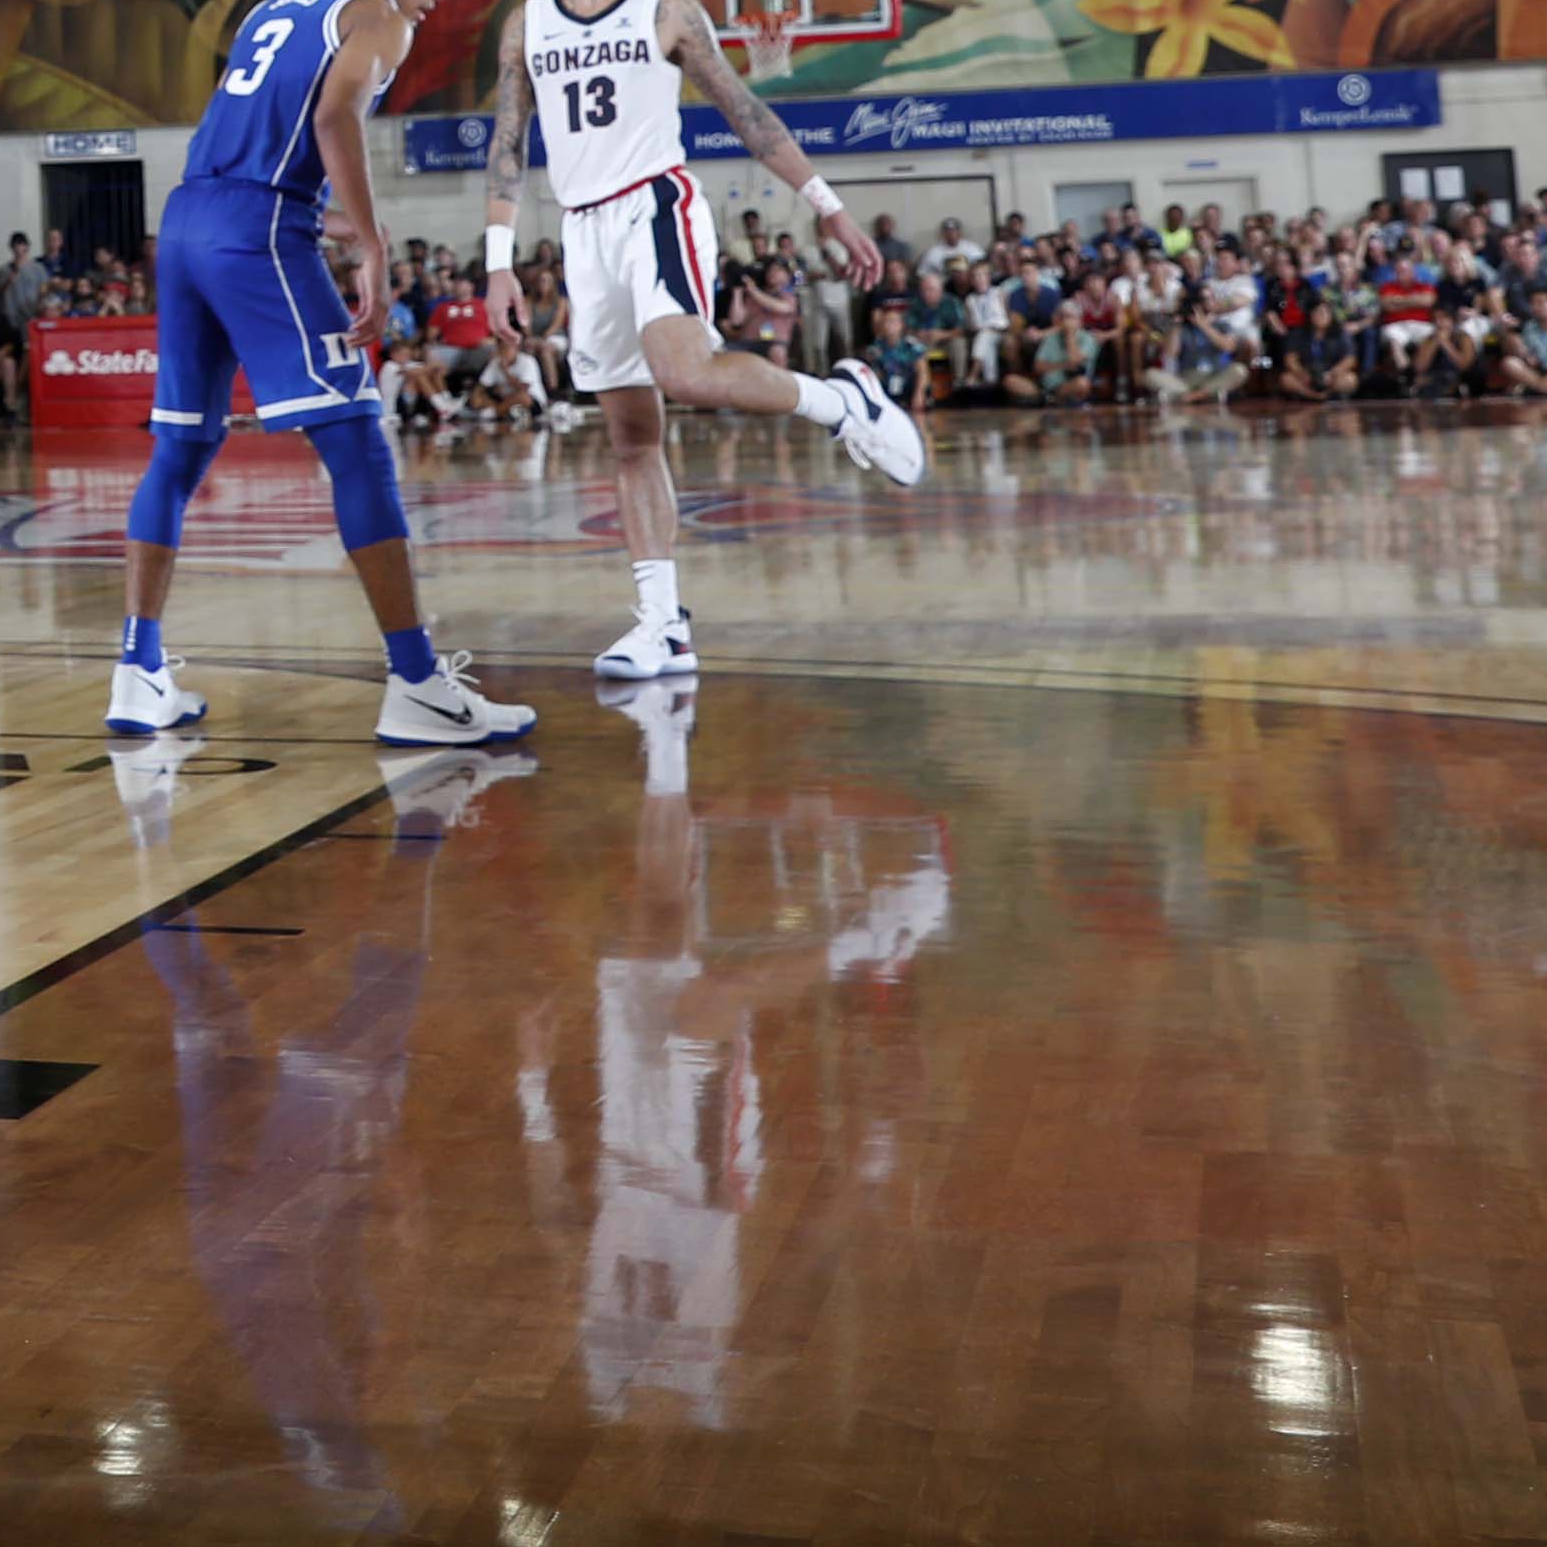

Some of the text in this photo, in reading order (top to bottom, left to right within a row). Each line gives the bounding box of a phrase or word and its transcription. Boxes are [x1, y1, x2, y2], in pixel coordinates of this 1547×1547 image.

[225, 17, 294, 96] 3
[532, 39, 652, 78] GONZAGA
[563, 75, 618, 134] 13
[911, 121, 966, 139] MAUI
[968, 114, 1114, 136] INVITATIONAL
